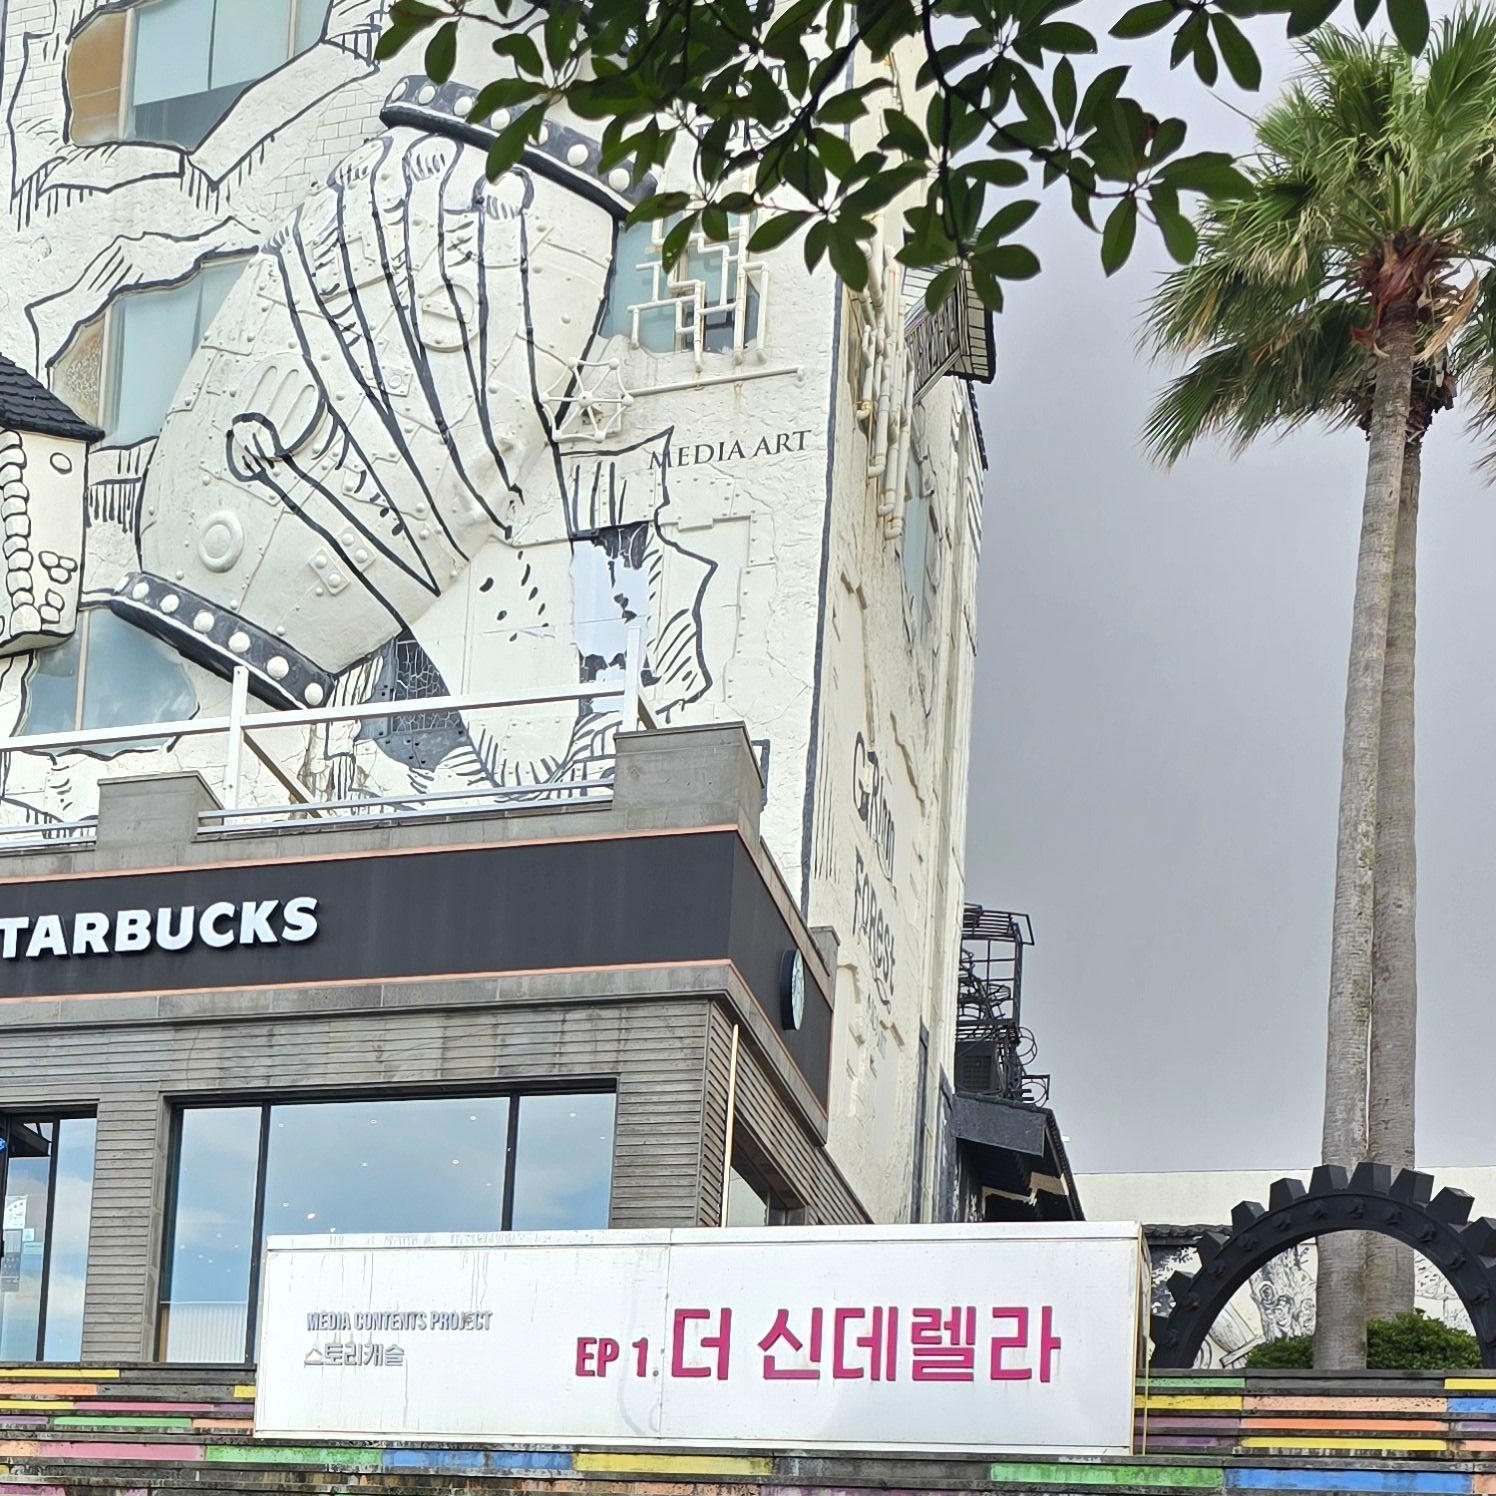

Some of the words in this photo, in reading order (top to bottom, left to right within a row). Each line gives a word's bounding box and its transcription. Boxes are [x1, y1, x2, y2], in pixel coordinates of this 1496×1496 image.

[649, 439, 746, 470] MEDIA
[751, 430, 812, 456] ART
[306, 1312, 352, 1332] MEDIA
[353, 1311, 428, 1332] CONTENTS
[429, 1310, 493, 1332] PROJECT
[304, 1343, 404, 1367] 스토리캐슬
[575, 1336, 620, 1378] EP
[671, 1307, 732, 1381] 더
[757, 1305, 1061, 1383] 신데렐라
